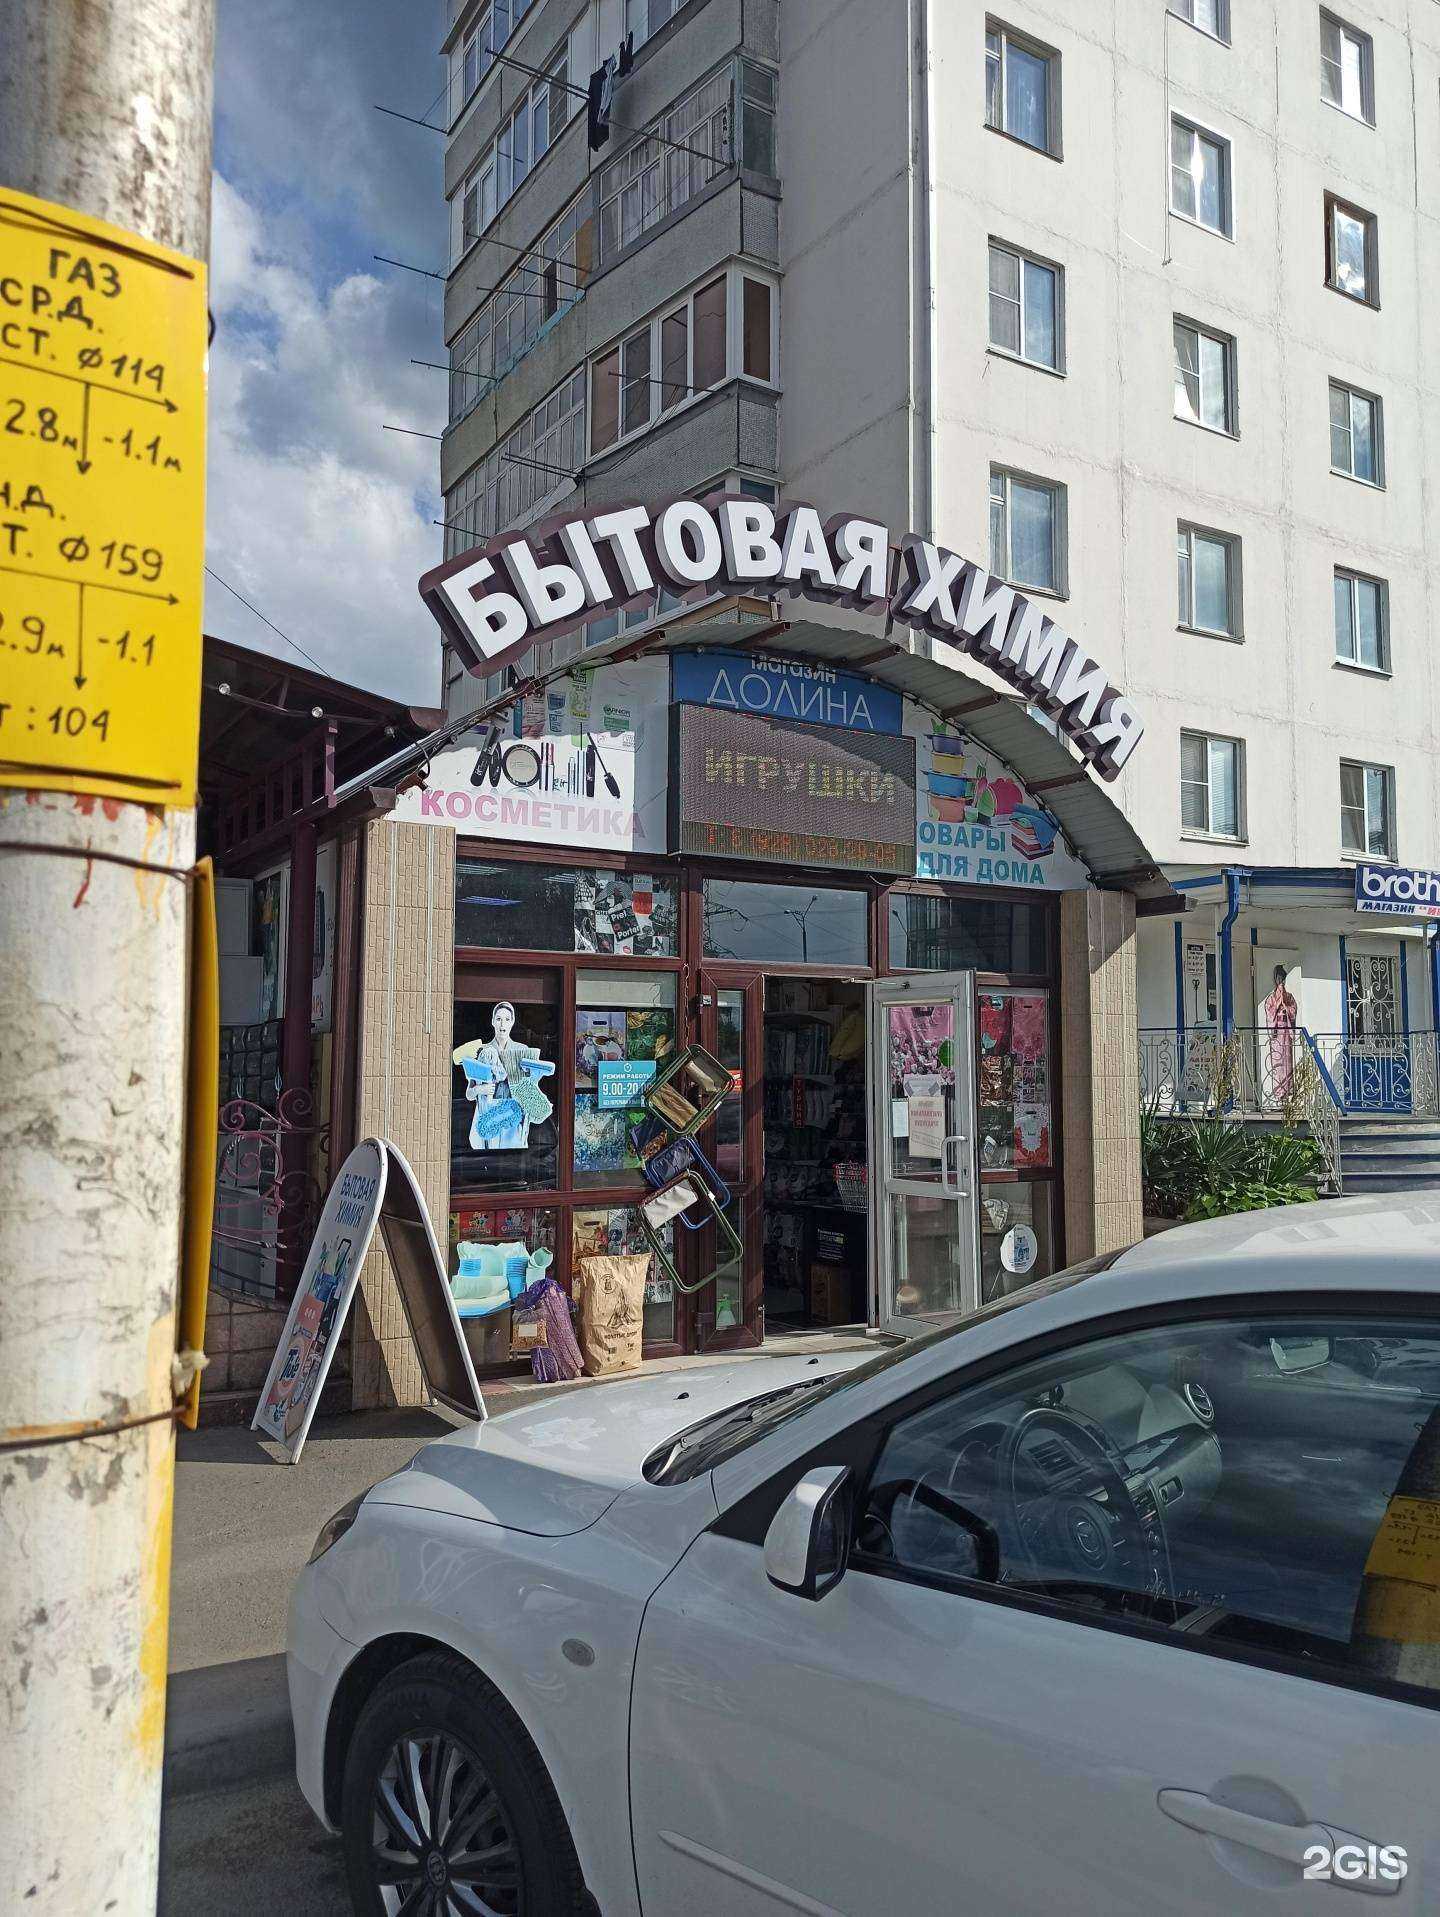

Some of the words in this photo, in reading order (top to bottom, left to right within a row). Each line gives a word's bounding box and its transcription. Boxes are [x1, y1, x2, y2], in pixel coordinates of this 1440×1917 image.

[49, 248, 122, 298] ГАЗ
[1, 322, 56, 360] СТ.
[0, 611, 65, 659] .9м
[97, 630, 156, 666] -1.1
[440, 500, 890, 659] БЫТОВАЯ
[902, 541, 1144, 769] ХИМИЯ
[707, 668, 875, 729] ДОЛИНА
[705, 749, 895, 804] ИГРУШКИ
[420, 789, 646, 838] КОСМЕТИКА
[918, 821, 1006, 852] ОВАРЫ
[917, 851, 969, 878] ДЛЯ
[976, 858, 1045, 885] ДОМА
[1362, 902, 1416, 914] МАГАЗИН
[340, 1173, 377, 1201] БЫТОВАЯ
[335, 1200, 365, 1229] ХИМИЯ
